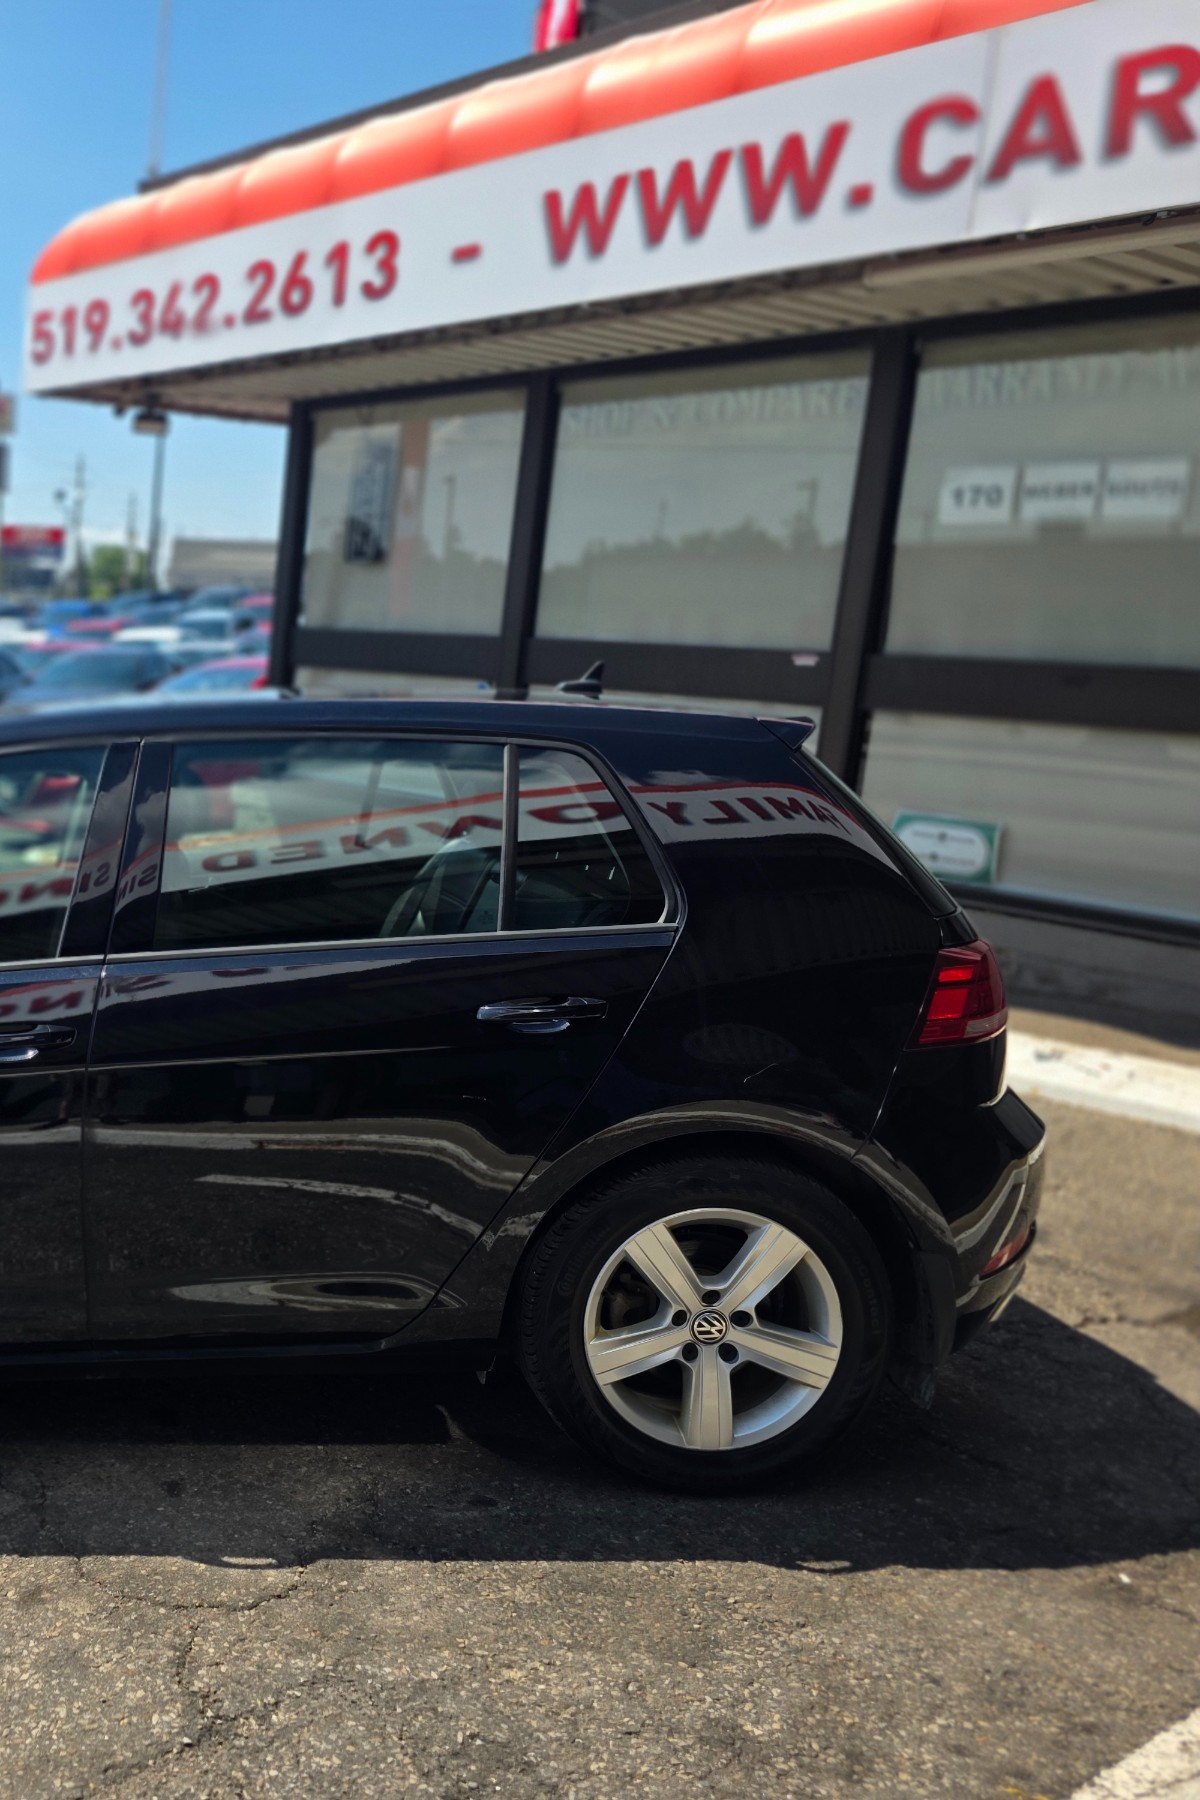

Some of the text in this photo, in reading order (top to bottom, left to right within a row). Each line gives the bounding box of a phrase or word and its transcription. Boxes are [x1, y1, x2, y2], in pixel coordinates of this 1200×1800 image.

[30, 229, 400, 364] 519.342.2613
[543, 43, 1200, 265] WWW.CAR
[952, 482, 1005, 509] 170
